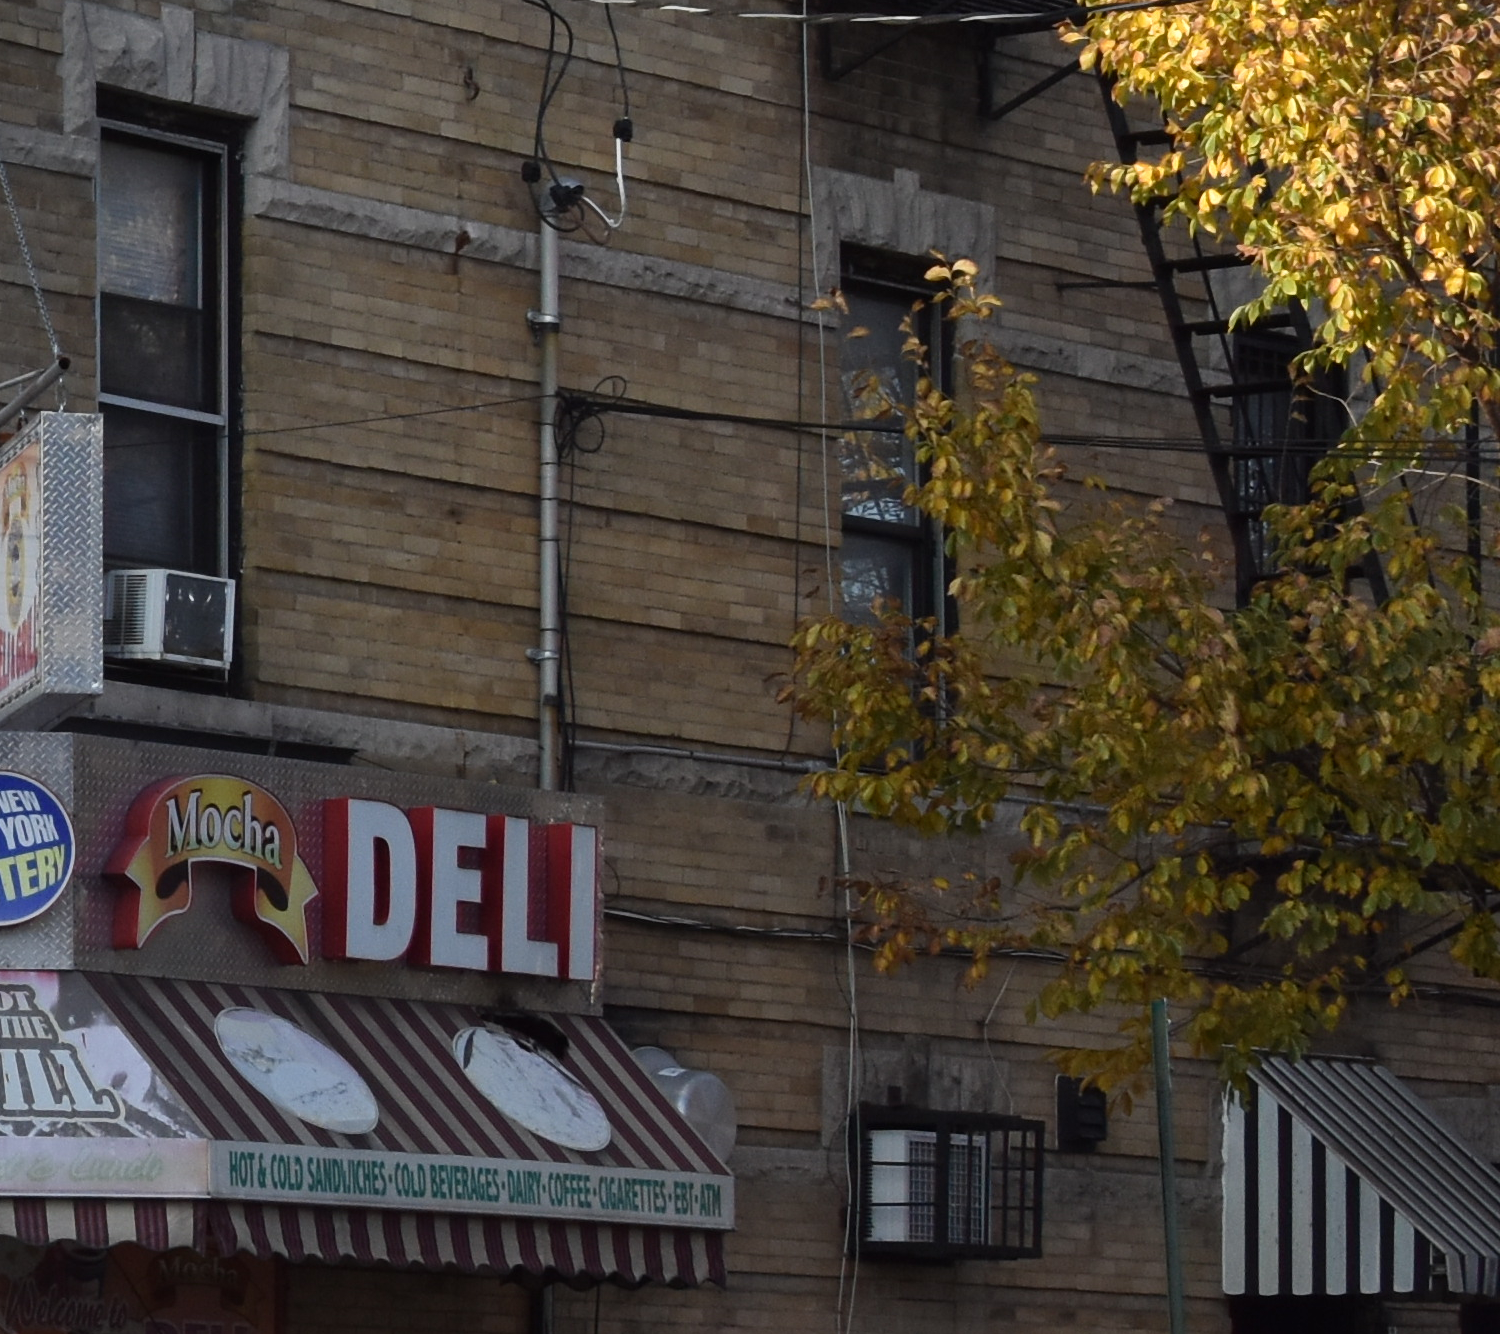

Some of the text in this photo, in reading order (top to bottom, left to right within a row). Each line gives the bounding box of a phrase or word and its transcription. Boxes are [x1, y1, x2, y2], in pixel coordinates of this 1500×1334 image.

[165, 789, 283, 869] Mocha
[346, 799, 596, 980] DELI
[229, 1151, 721, 1217] HOT & COLD SANDWICHES COLD BEVERAGES DAIRY COFFEE CIGARETTES EBT ATM
[159, 1255, 237, 1283] Mocha
[1, 1277, 127, 1330] Welcome to
